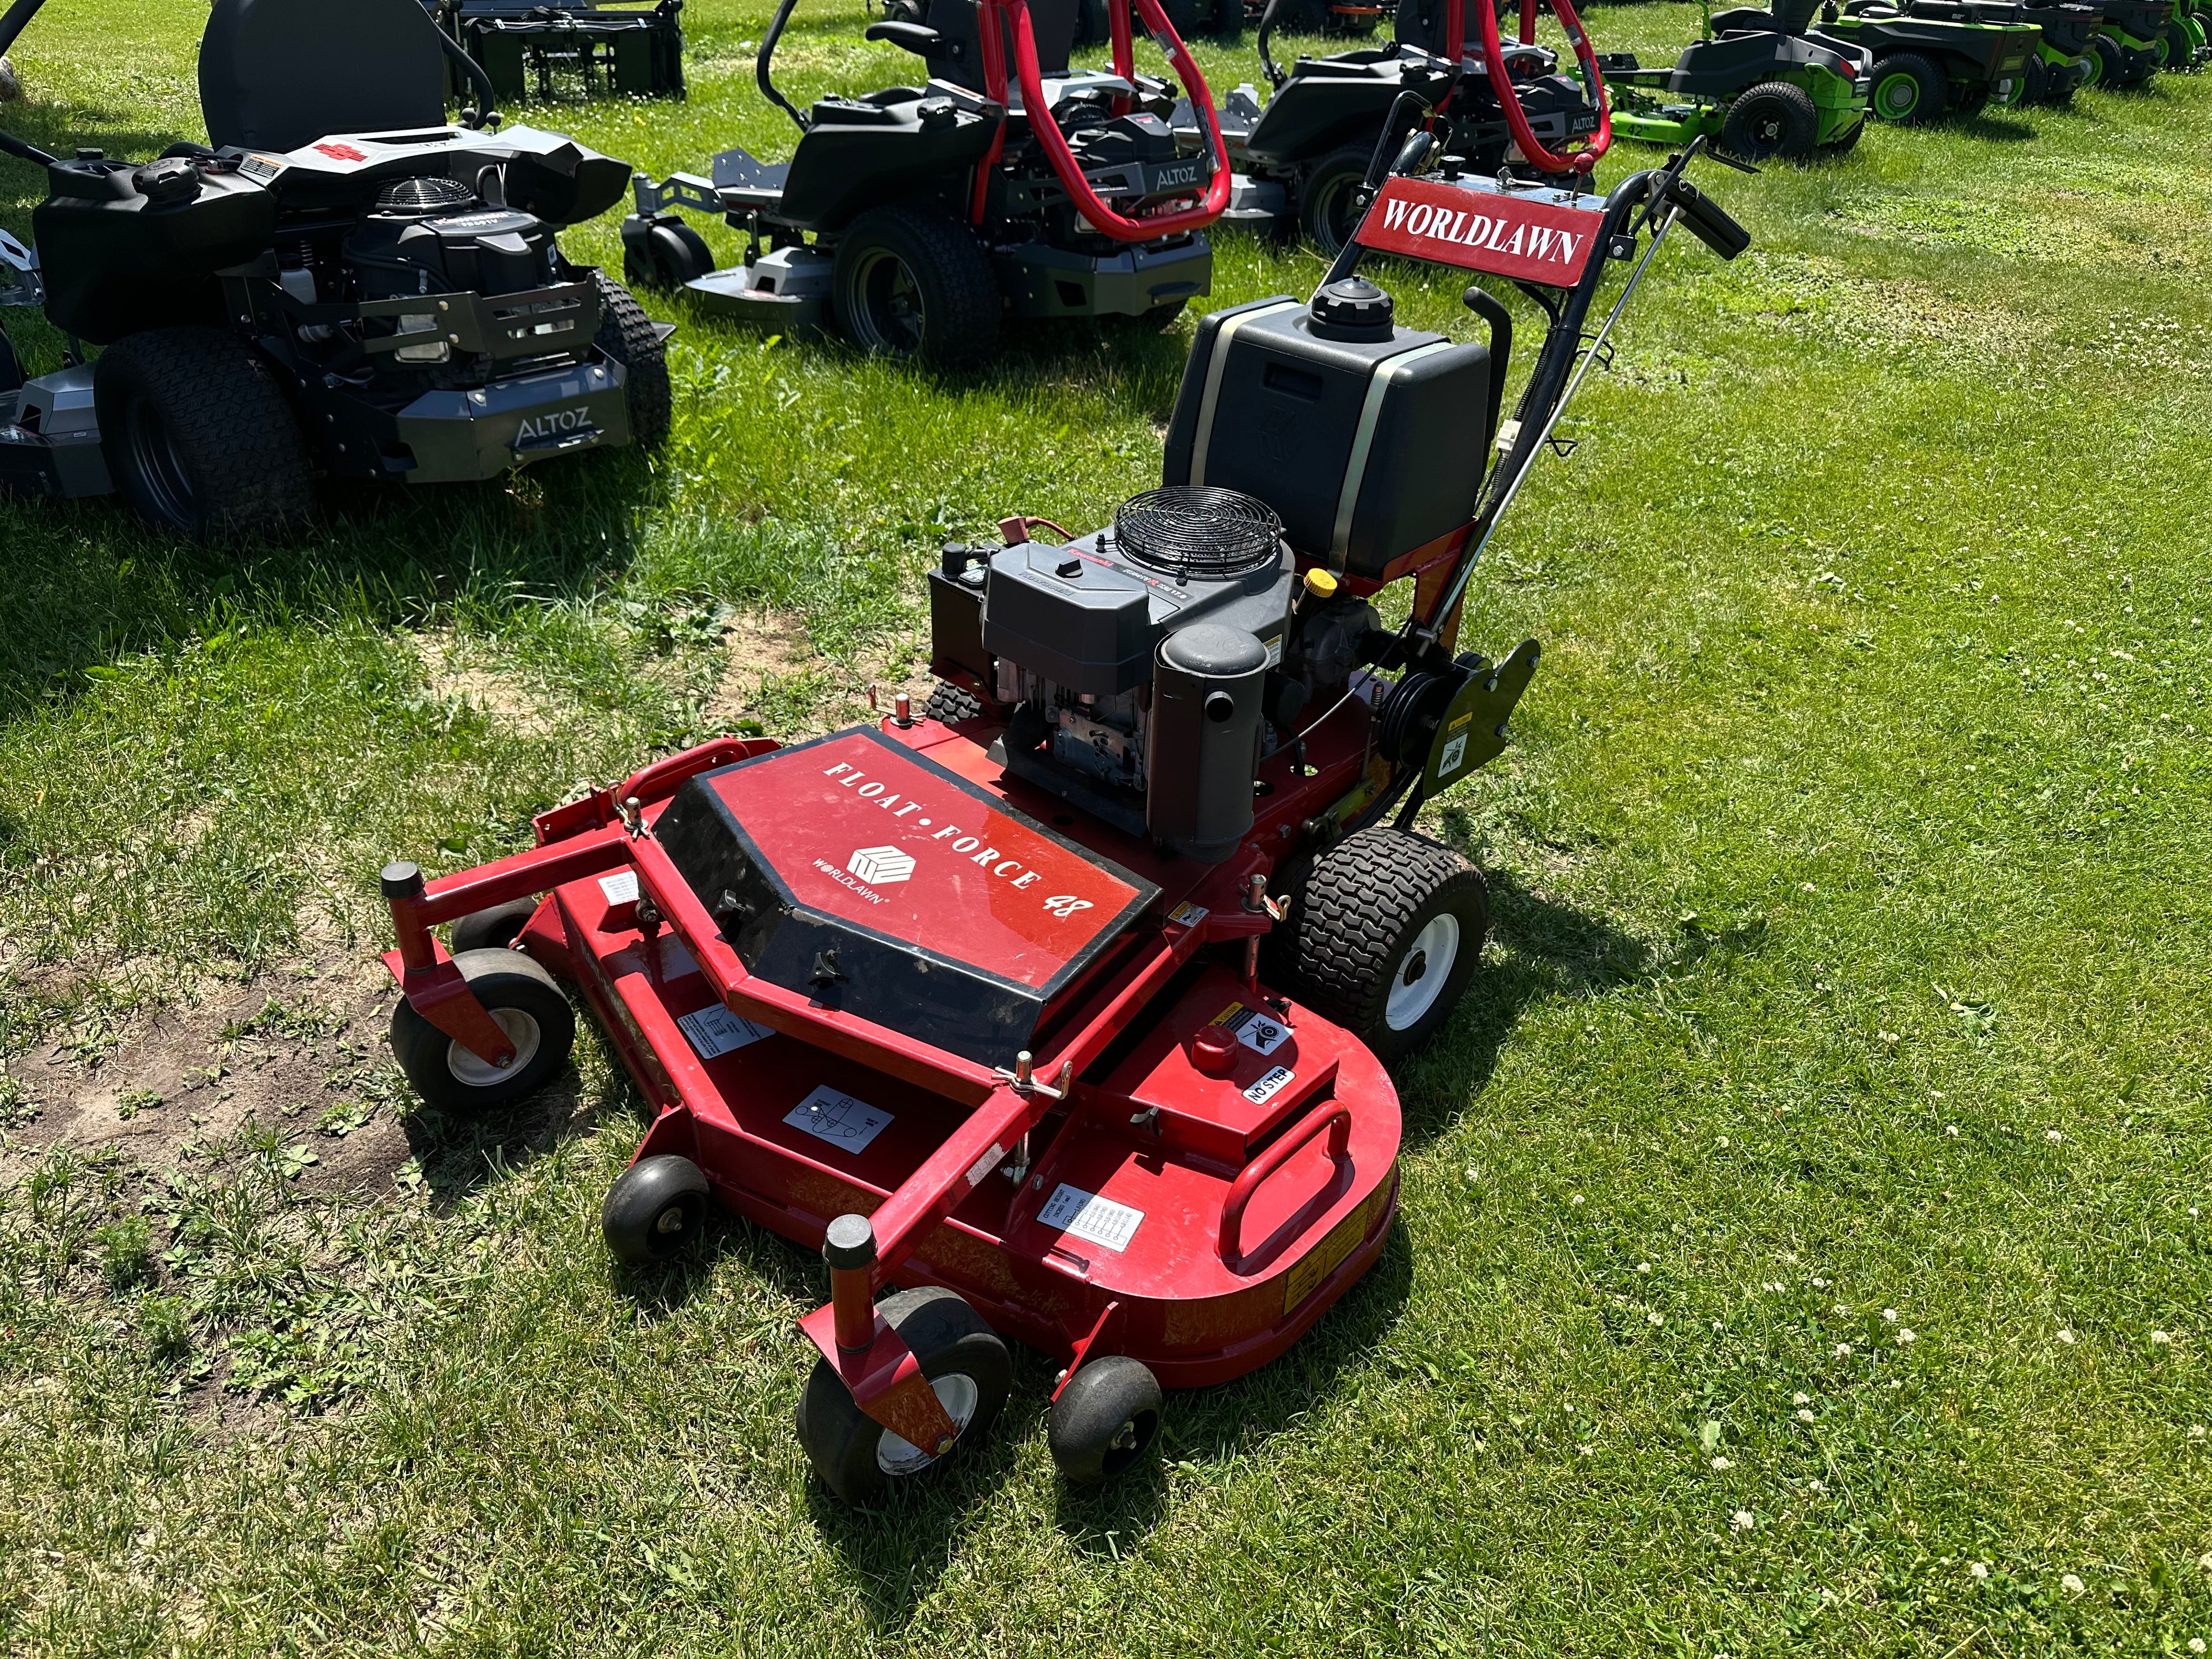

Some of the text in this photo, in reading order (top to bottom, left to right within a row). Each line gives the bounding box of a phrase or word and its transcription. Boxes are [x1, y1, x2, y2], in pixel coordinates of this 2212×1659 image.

[1571, 116, 1595, 134] ALTOZ
[1156, 165, 1198, 192] ALTOZ
[1383, 198, 1584, 265] WORLDLAWN
[515, 406, 593, 448] ALTOZ
[823, 762, 1094, 917] FLOAT FORCE 48
[1220, 1005, 1239, 1021] CAUTION
[1248, 1069, 1289, 1101] NO STEP
[1043, 1188, 1066, 1219] CUTTING HEIGHT
[1052, 1203, 1065, 1218] INCHES
